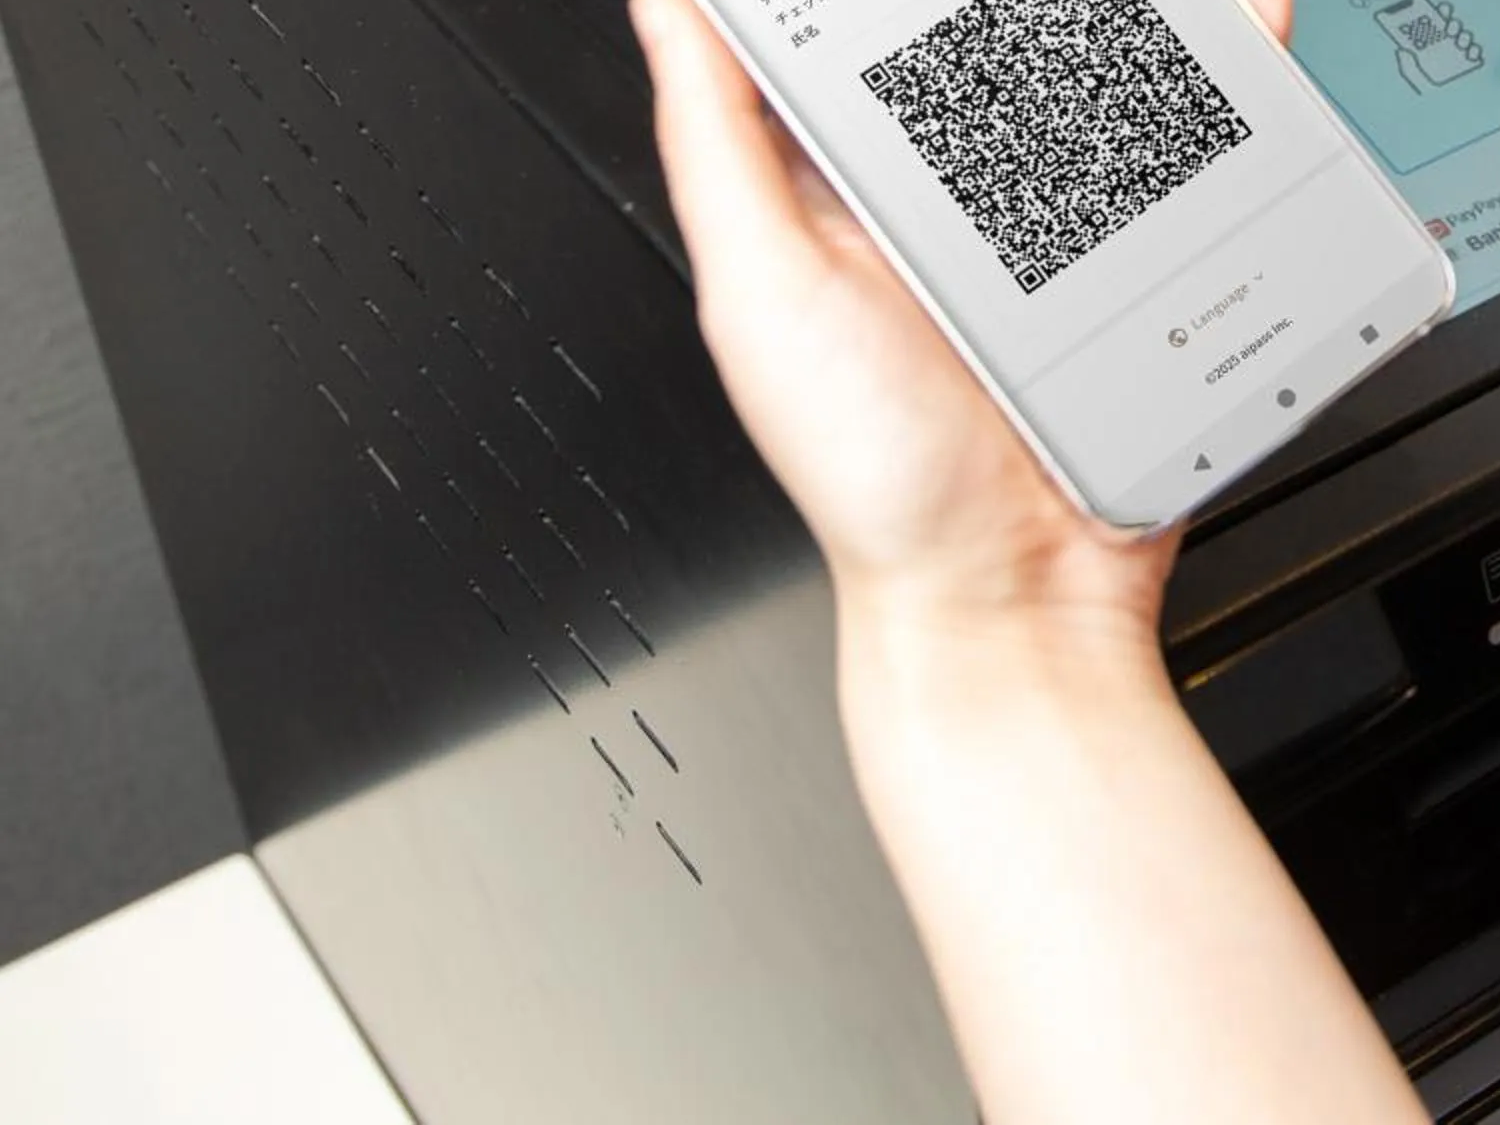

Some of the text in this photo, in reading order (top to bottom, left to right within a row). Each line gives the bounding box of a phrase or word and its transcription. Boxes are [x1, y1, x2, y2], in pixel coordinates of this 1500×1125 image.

[791, 24, 820, 48] 氏名
[1191, 283, 1249, 330] Language
[1240, 331, 1274, 359] aipass
